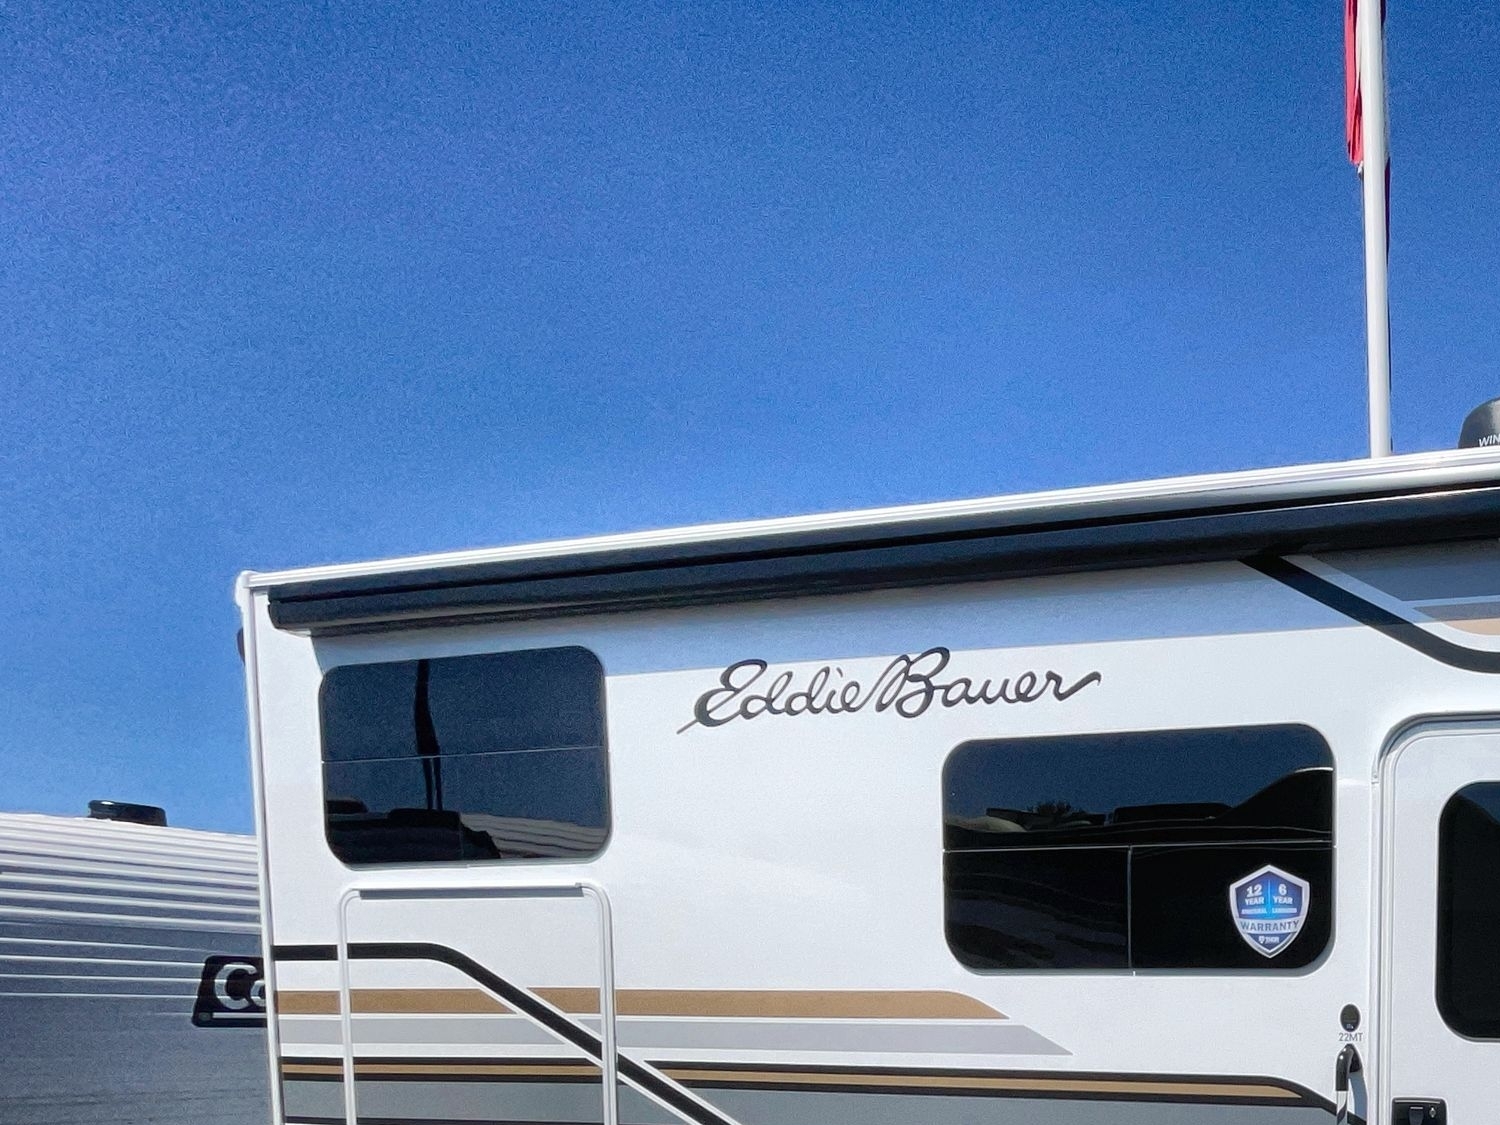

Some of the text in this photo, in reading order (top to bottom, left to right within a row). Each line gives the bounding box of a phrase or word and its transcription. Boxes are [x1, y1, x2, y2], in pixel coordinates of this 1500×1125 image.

[676, 646, 1101, 735] Eddie Bauer
[1247, 884, 1262, 896] 12
[1278, 884, 1287, 895] 6
[1245, 897, 1264, 905] YEAR
[1273, 896, 1293, 904] YEAR
[1240, 920, 1299, 931] WARRANTY
[1338, 1032, 1363, 1042] 22MT
